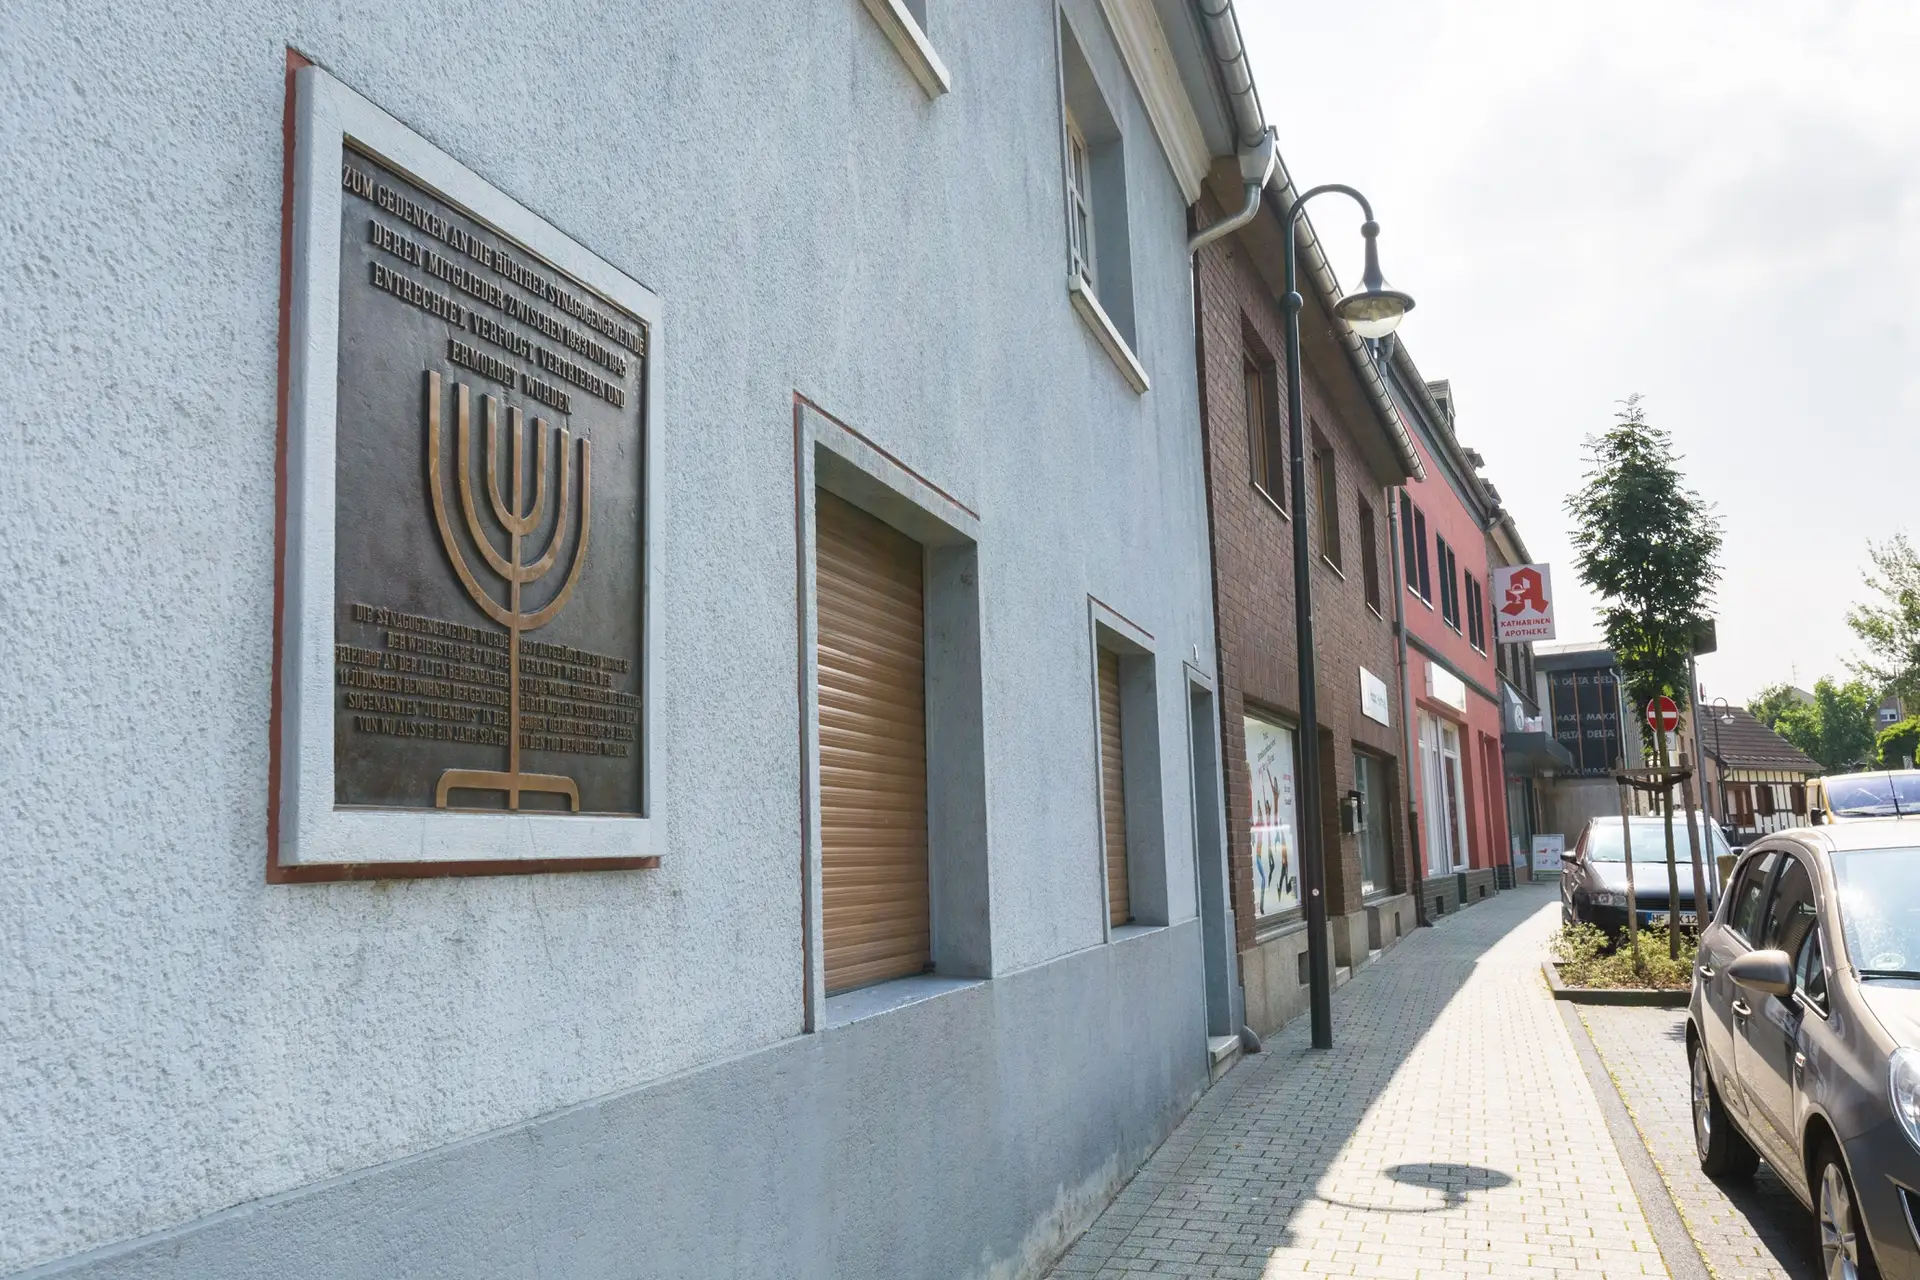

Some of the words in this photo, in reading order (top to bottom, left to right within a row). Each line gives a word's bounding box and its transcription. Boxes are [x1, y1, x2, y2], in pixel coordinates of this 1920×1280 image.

[343, 164, 374, 200] ZUM
[378, 184, 448, 242] GEDENKEN
[451, 226, 469, 253] AN
[471, 236, 492, 266] DIE
[495, 252, 546, 298] HÜRTHER
[373, 220, 422, 266] DEREN
[428, 251, 504, 310] MITGLIEDER
[508, 294, 564, 343] ZWISCHEN
[566, 327, 588, 354] 1933
[589, 340, 608, 366] UND
[608, 350, 628, 376] 1945
[452, 340, 519, 388] ERMORDET
[540, 347, 605, 398] VERTRIEBEN
[608, 383, 626, 408] UND
[356, 603, 373, 622] DIE
[376, 606, 476, 642] SYNAGOGENGEMEINDE
[480, 629, 509, 648] WURDE
[520, 636, 537, 654] 1937
[1500, 618, 1551, 628] KATHARINEN
[1504, 628, 1548, 637] APOTHEKE
[334, 644, 382, 667] FRIEDHOF
[384, 653, 396, 670] AN
[400, 655, 418, 672] DER
[420, 658, 447, 677] ALTEN
[449, 663, 509, 687] BERRENRATHER
[388, 632, 406, 649] DER
[472, 648, 482, 662] 47
[520, 658, 560, 678] VERKAUFT
[350, 667, 402, 692] JÜDISCHEN
[404, 677, 451, 698] BEWOHNER
[453, 684, 468, 700] DER
[470, 686, 509, 707] GEMEINDE
[520, 692, 545, 712] HÜRTH
[1562, 676, 1589, 686] DETA
[348, 692, 418, 716] SOGENANNTEN
[483, 708, 492, 724] IN
[494, 710, 509, 726] DER
[358, 716, 378, 732] VON
[381, 718, 396, 734] WO
[398, 719, 416, 736] AUS
[420, 722, 434, 738] SIE
[438, 724, 452, 740] EIN
[454, 725, 476, 742] JAHR
[480, 727, 509, 746] SPÄTER
[520, 732, 529, 748] IN
